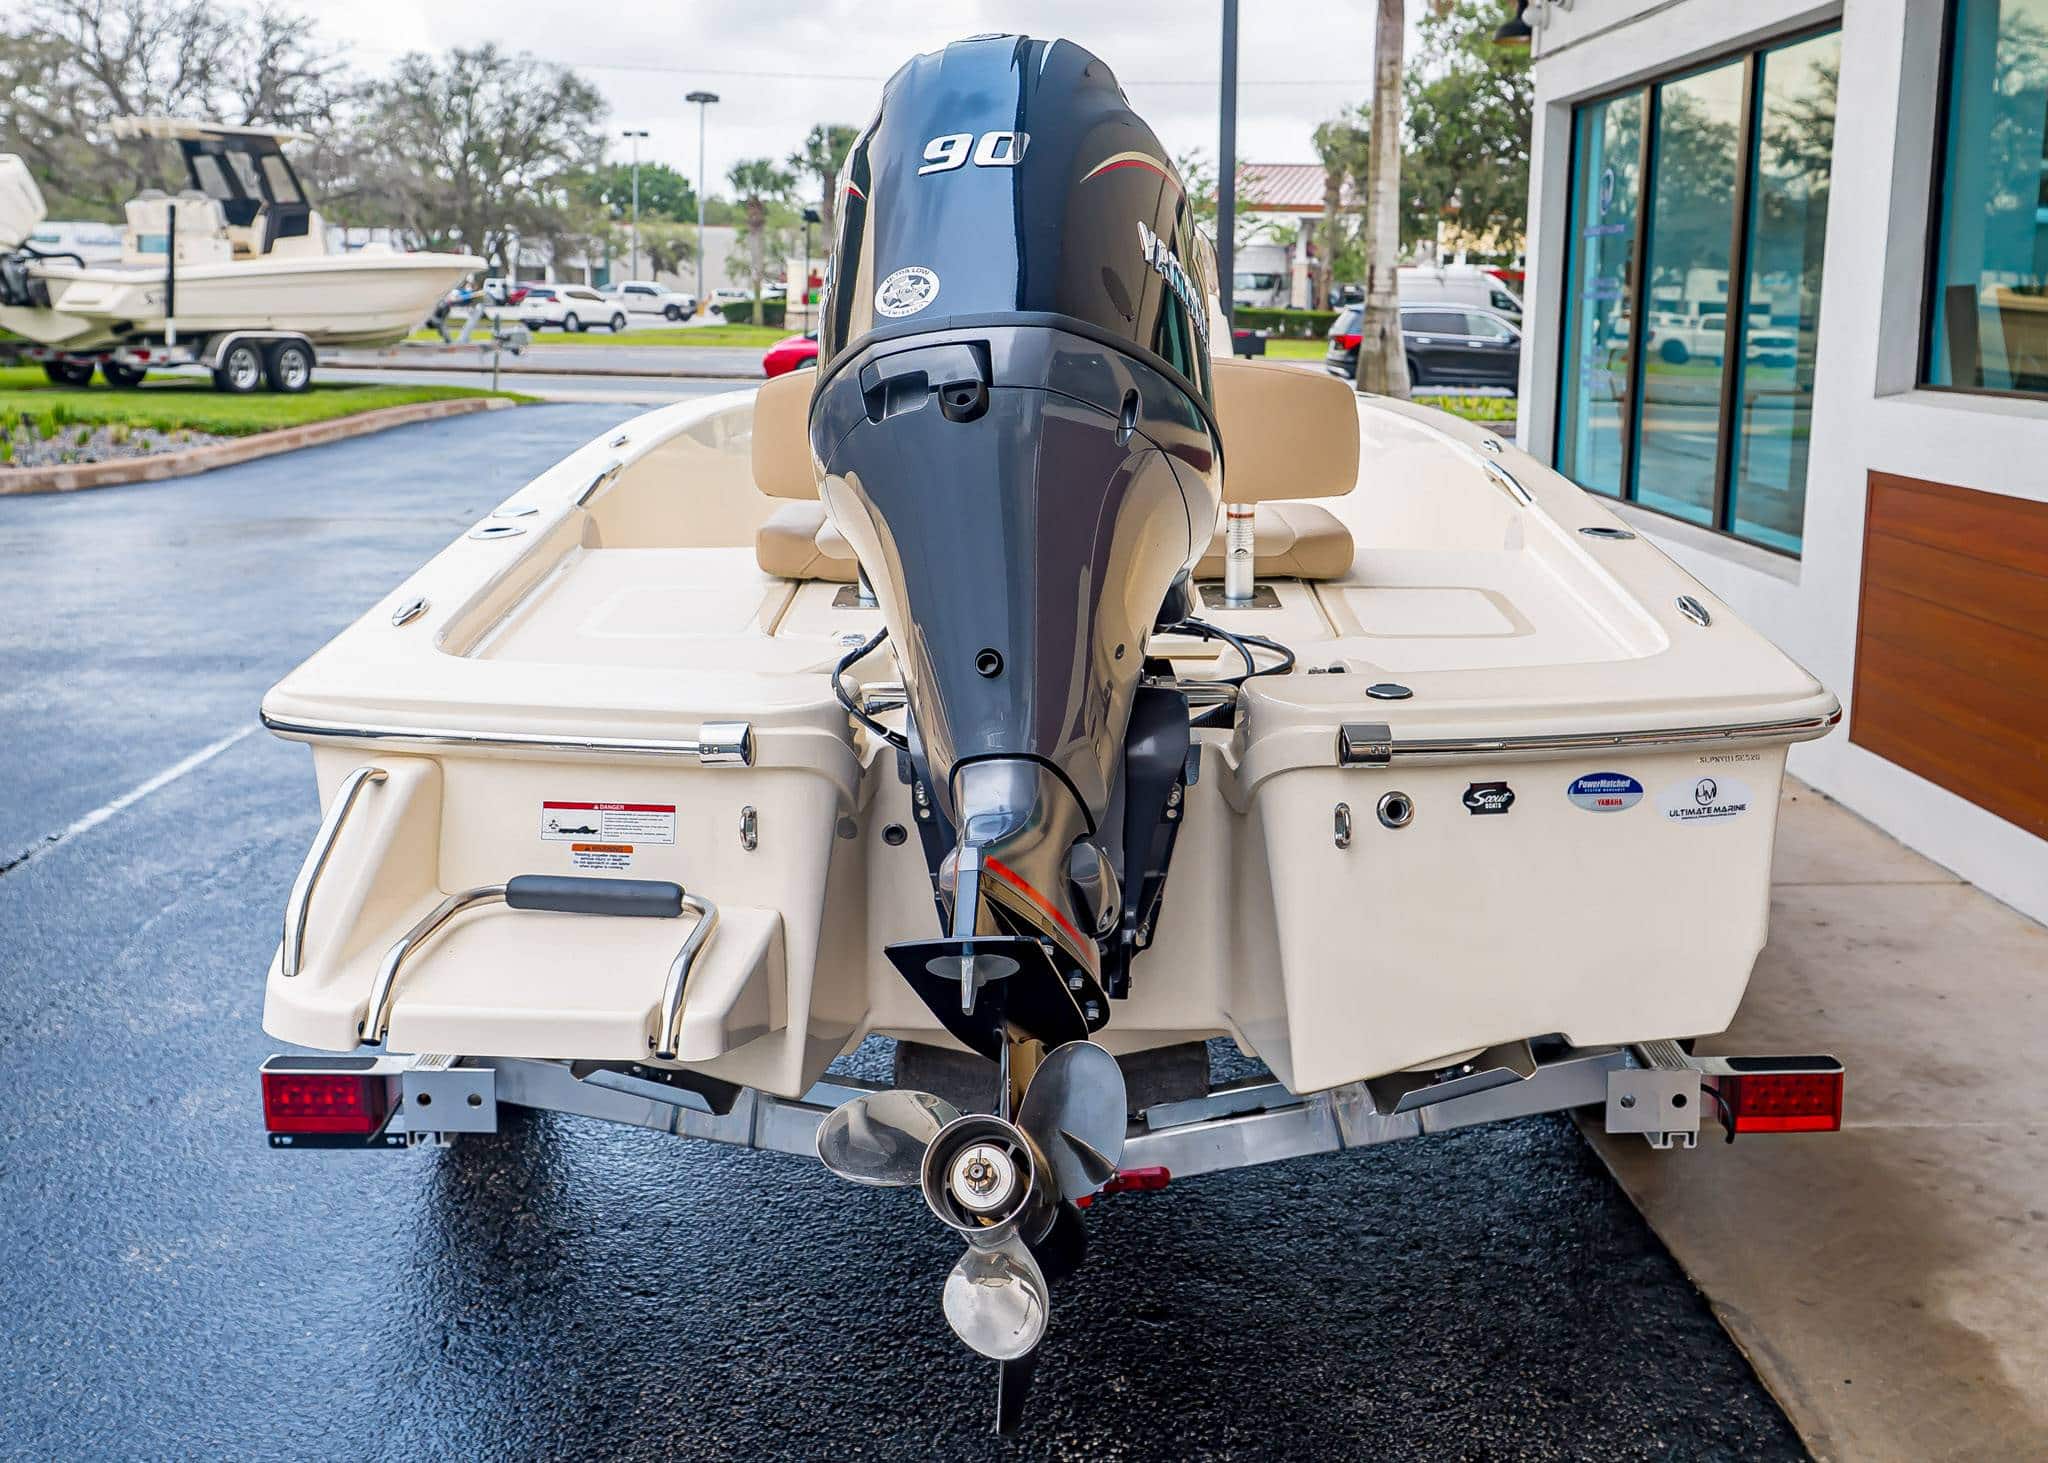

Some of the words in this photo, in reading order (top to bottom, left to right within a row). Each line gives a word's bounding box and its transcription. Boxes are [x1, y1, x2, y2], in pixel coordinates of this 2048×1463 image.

[918, 131, 1030, 177] 90
[1578, 780, 1631, 789] PowerMatched
[1465, 789, 1512, 807] Scout
[1597, 798, 1623, 806] YAMAHA
[1669, 806, 1712, 817] ULTIMATE
[1713, 803, 1746, 814] MARINE
